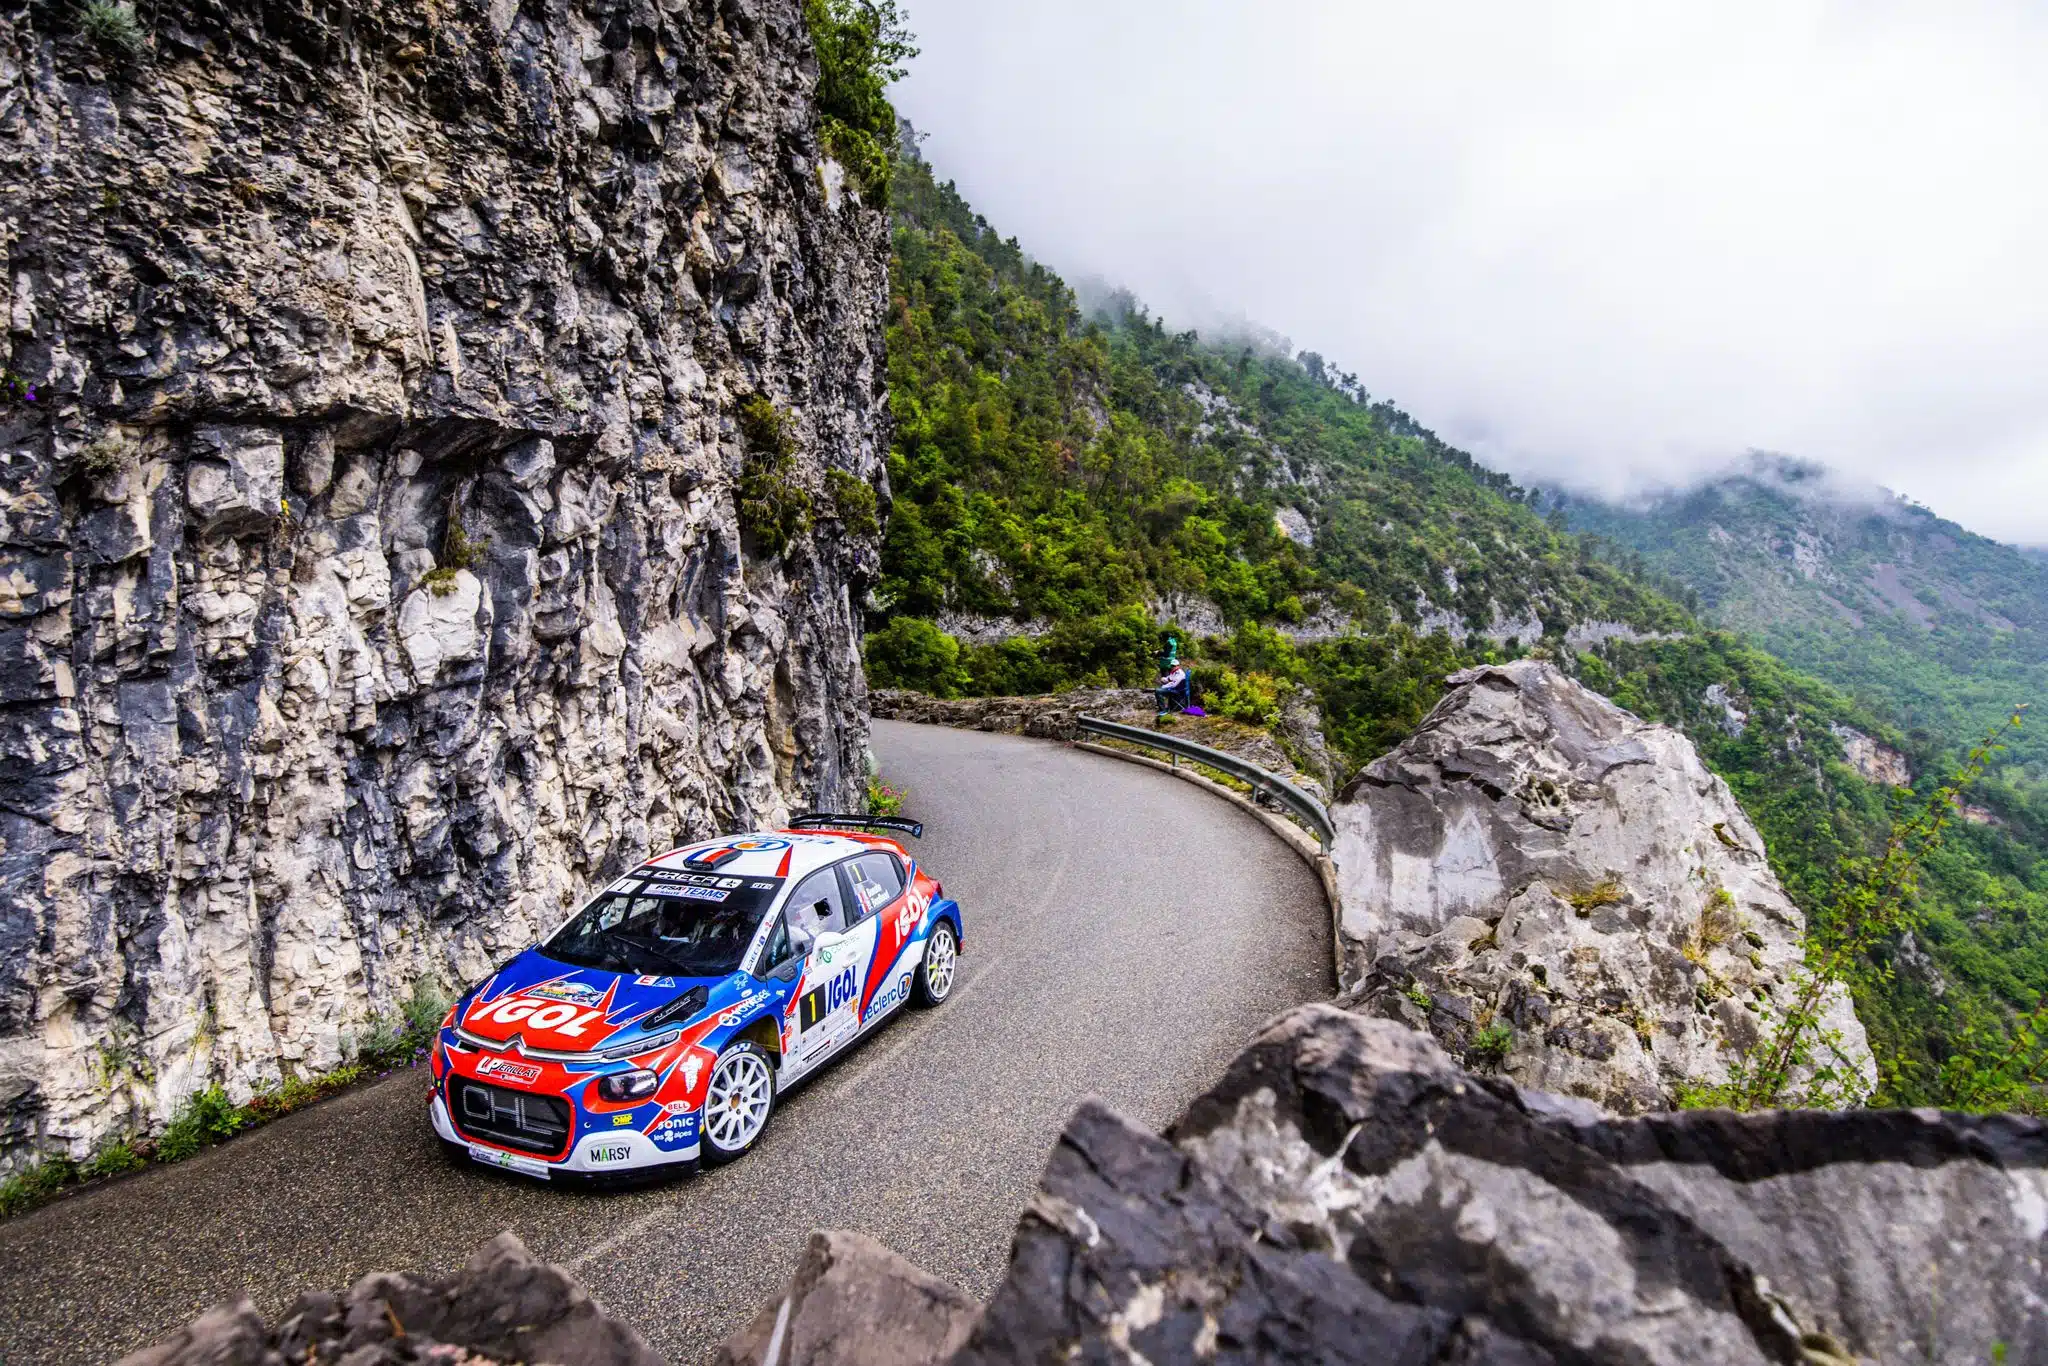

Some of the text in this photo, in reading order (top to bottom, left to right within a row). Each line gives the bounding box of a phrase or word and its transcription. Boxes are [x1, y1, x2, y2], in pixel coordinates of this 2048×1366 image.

[653, 871, 719, 885] ORECA
[685, 886, 727, 899] TEAMS
[827, 965, 857, 1014] IGOL
[809, 993, 816, 1023] 1
[469, 997, 605, 1037] IGOL
[462, 1085, 552, 1135] CHL
[612, 1114, 633, 1126] OMP
[664, 1130, 673, 1142] 2
[590, 1147, 631, 1162] MARSY
